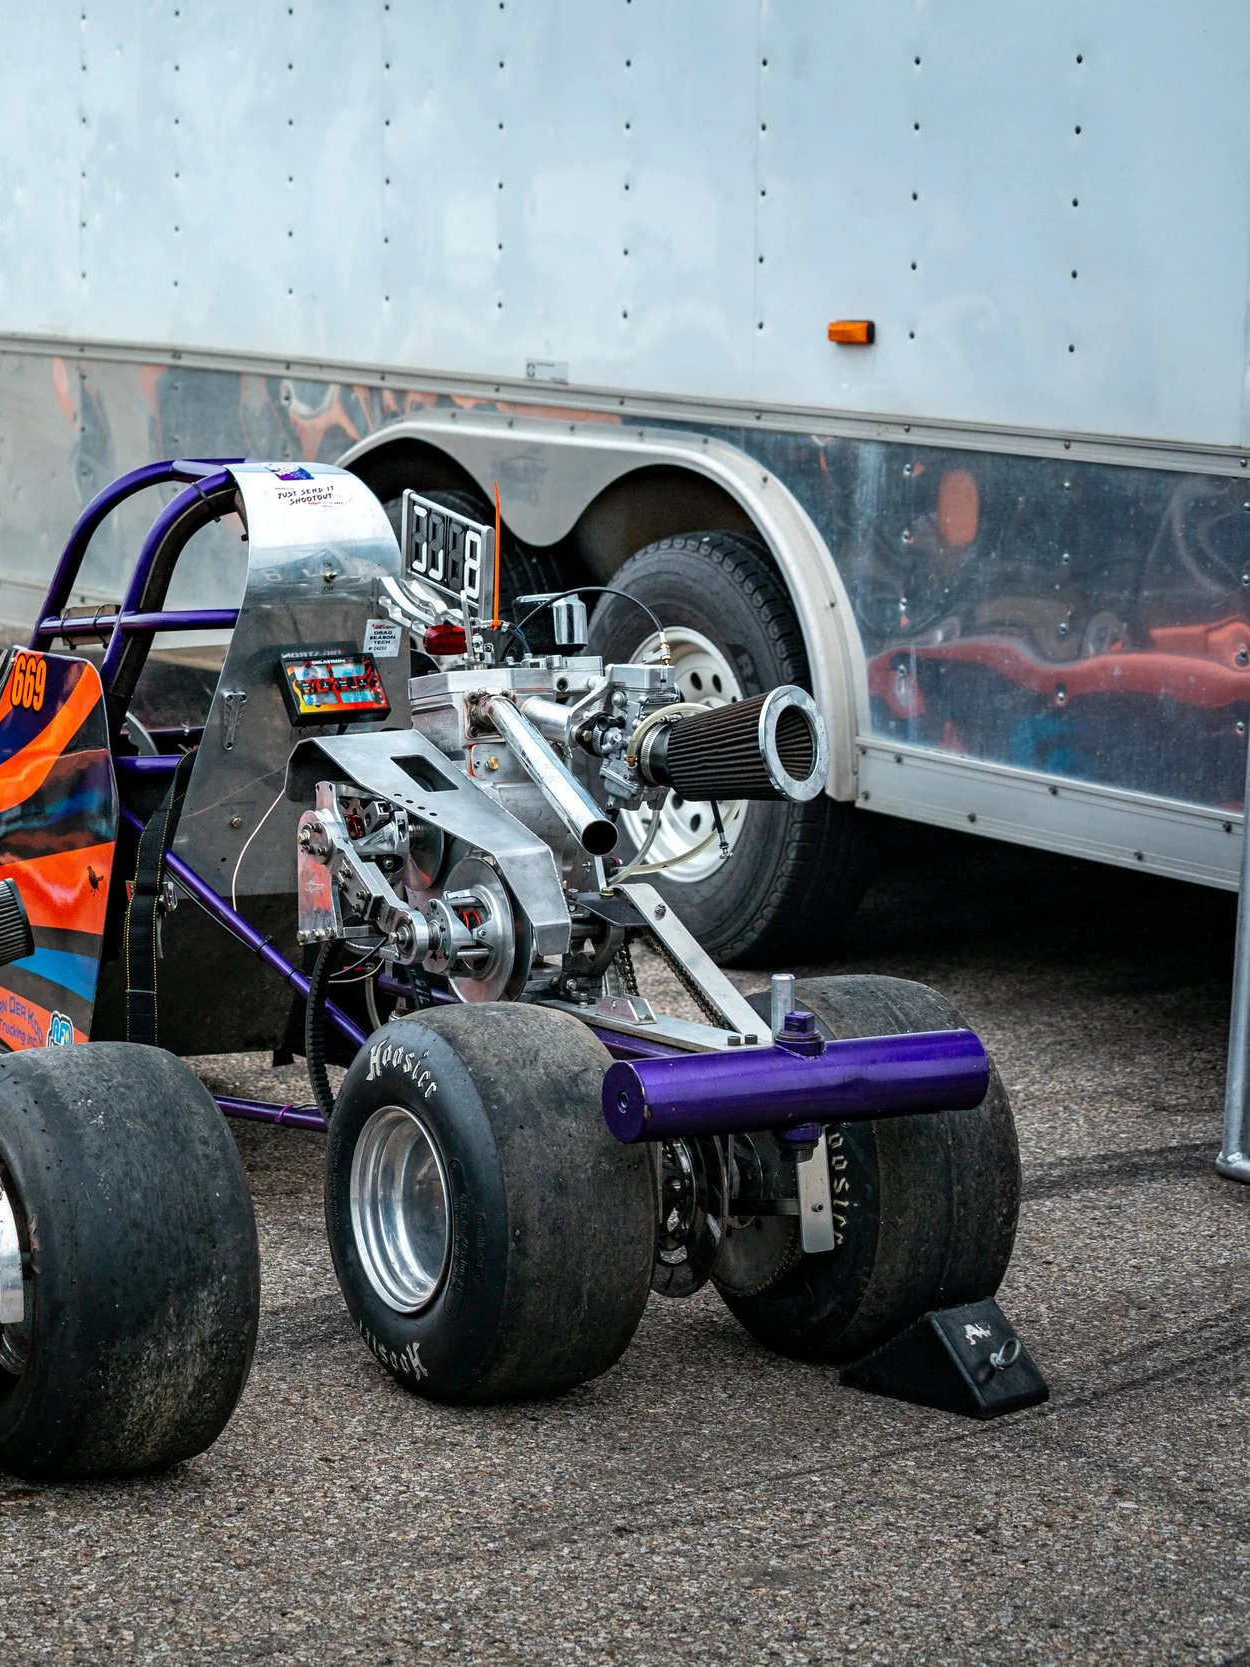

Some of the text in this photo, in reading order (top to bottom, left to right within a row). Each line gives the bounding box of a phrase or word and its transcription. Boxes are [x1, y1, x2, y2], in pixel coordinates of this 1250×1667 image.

[277, 491, 297, 499] JUST
[300, 487, 324, 496] SEND
[289, 493, 332, 505] SHOOTOUT
[10, 653, 47, 713] 669
